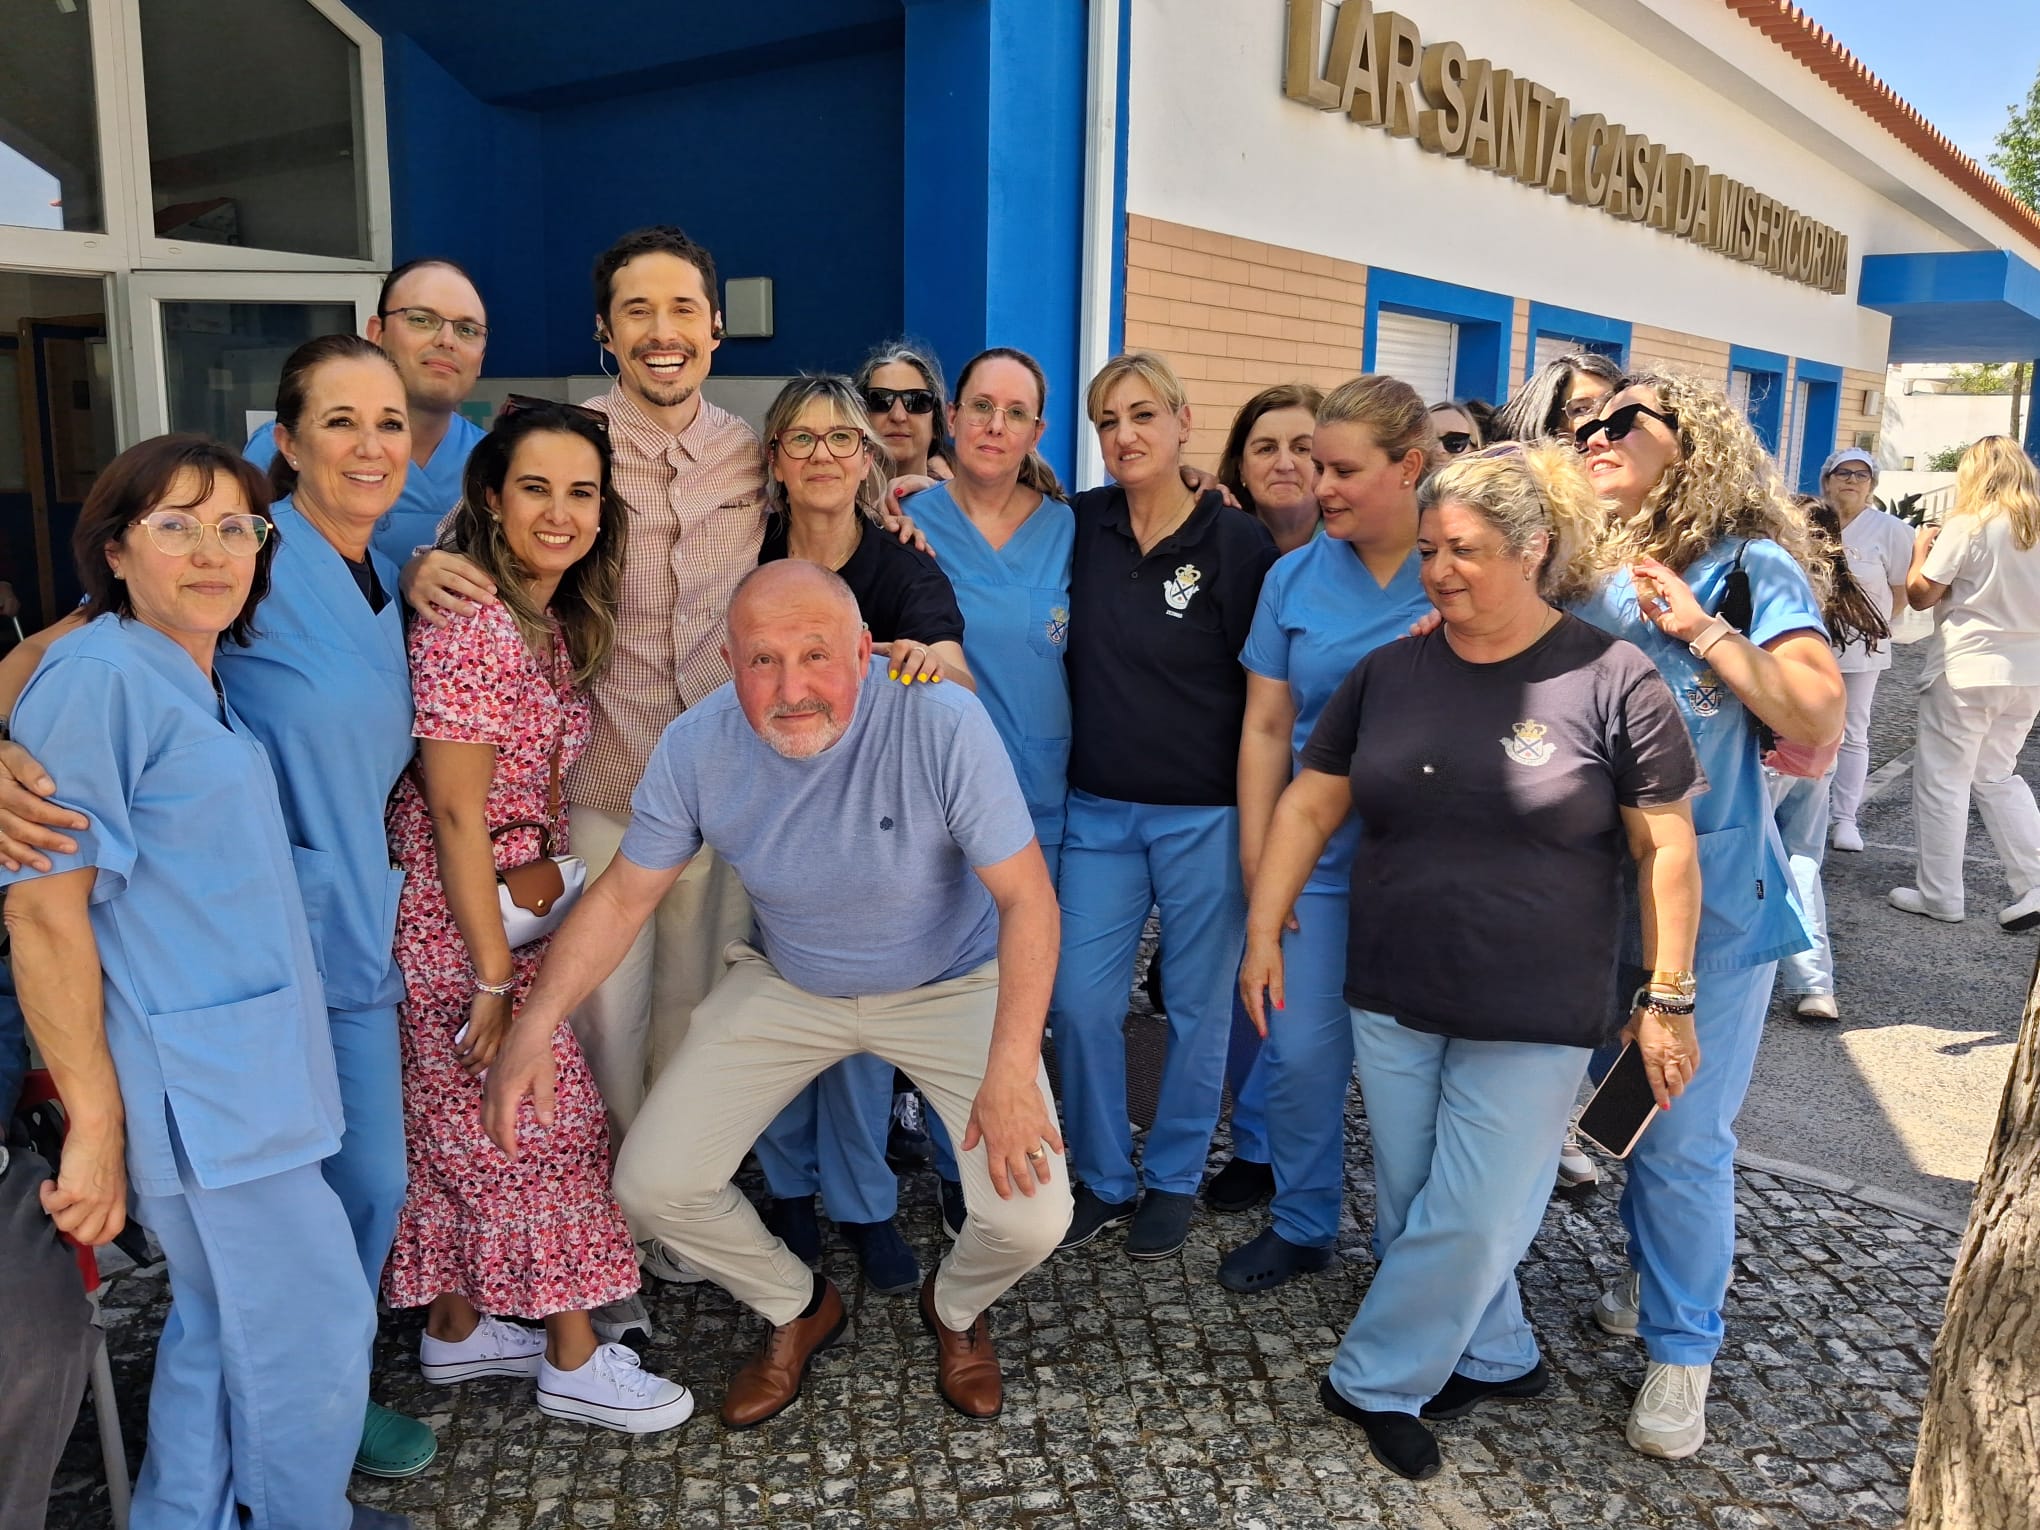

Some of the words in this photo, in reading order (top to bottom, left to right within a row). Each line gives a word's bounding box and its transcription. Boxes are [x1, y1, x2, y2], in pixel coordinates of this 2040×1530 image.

[1289, 0, 1420, 138] LAR
[1421, 41, 1574, 196] SANTA
[1574, 113, 1667, 229] CASA
[1669, 153, 1710, 244] DA
[1711, 174, 1849, 295] MISERICORDIA
